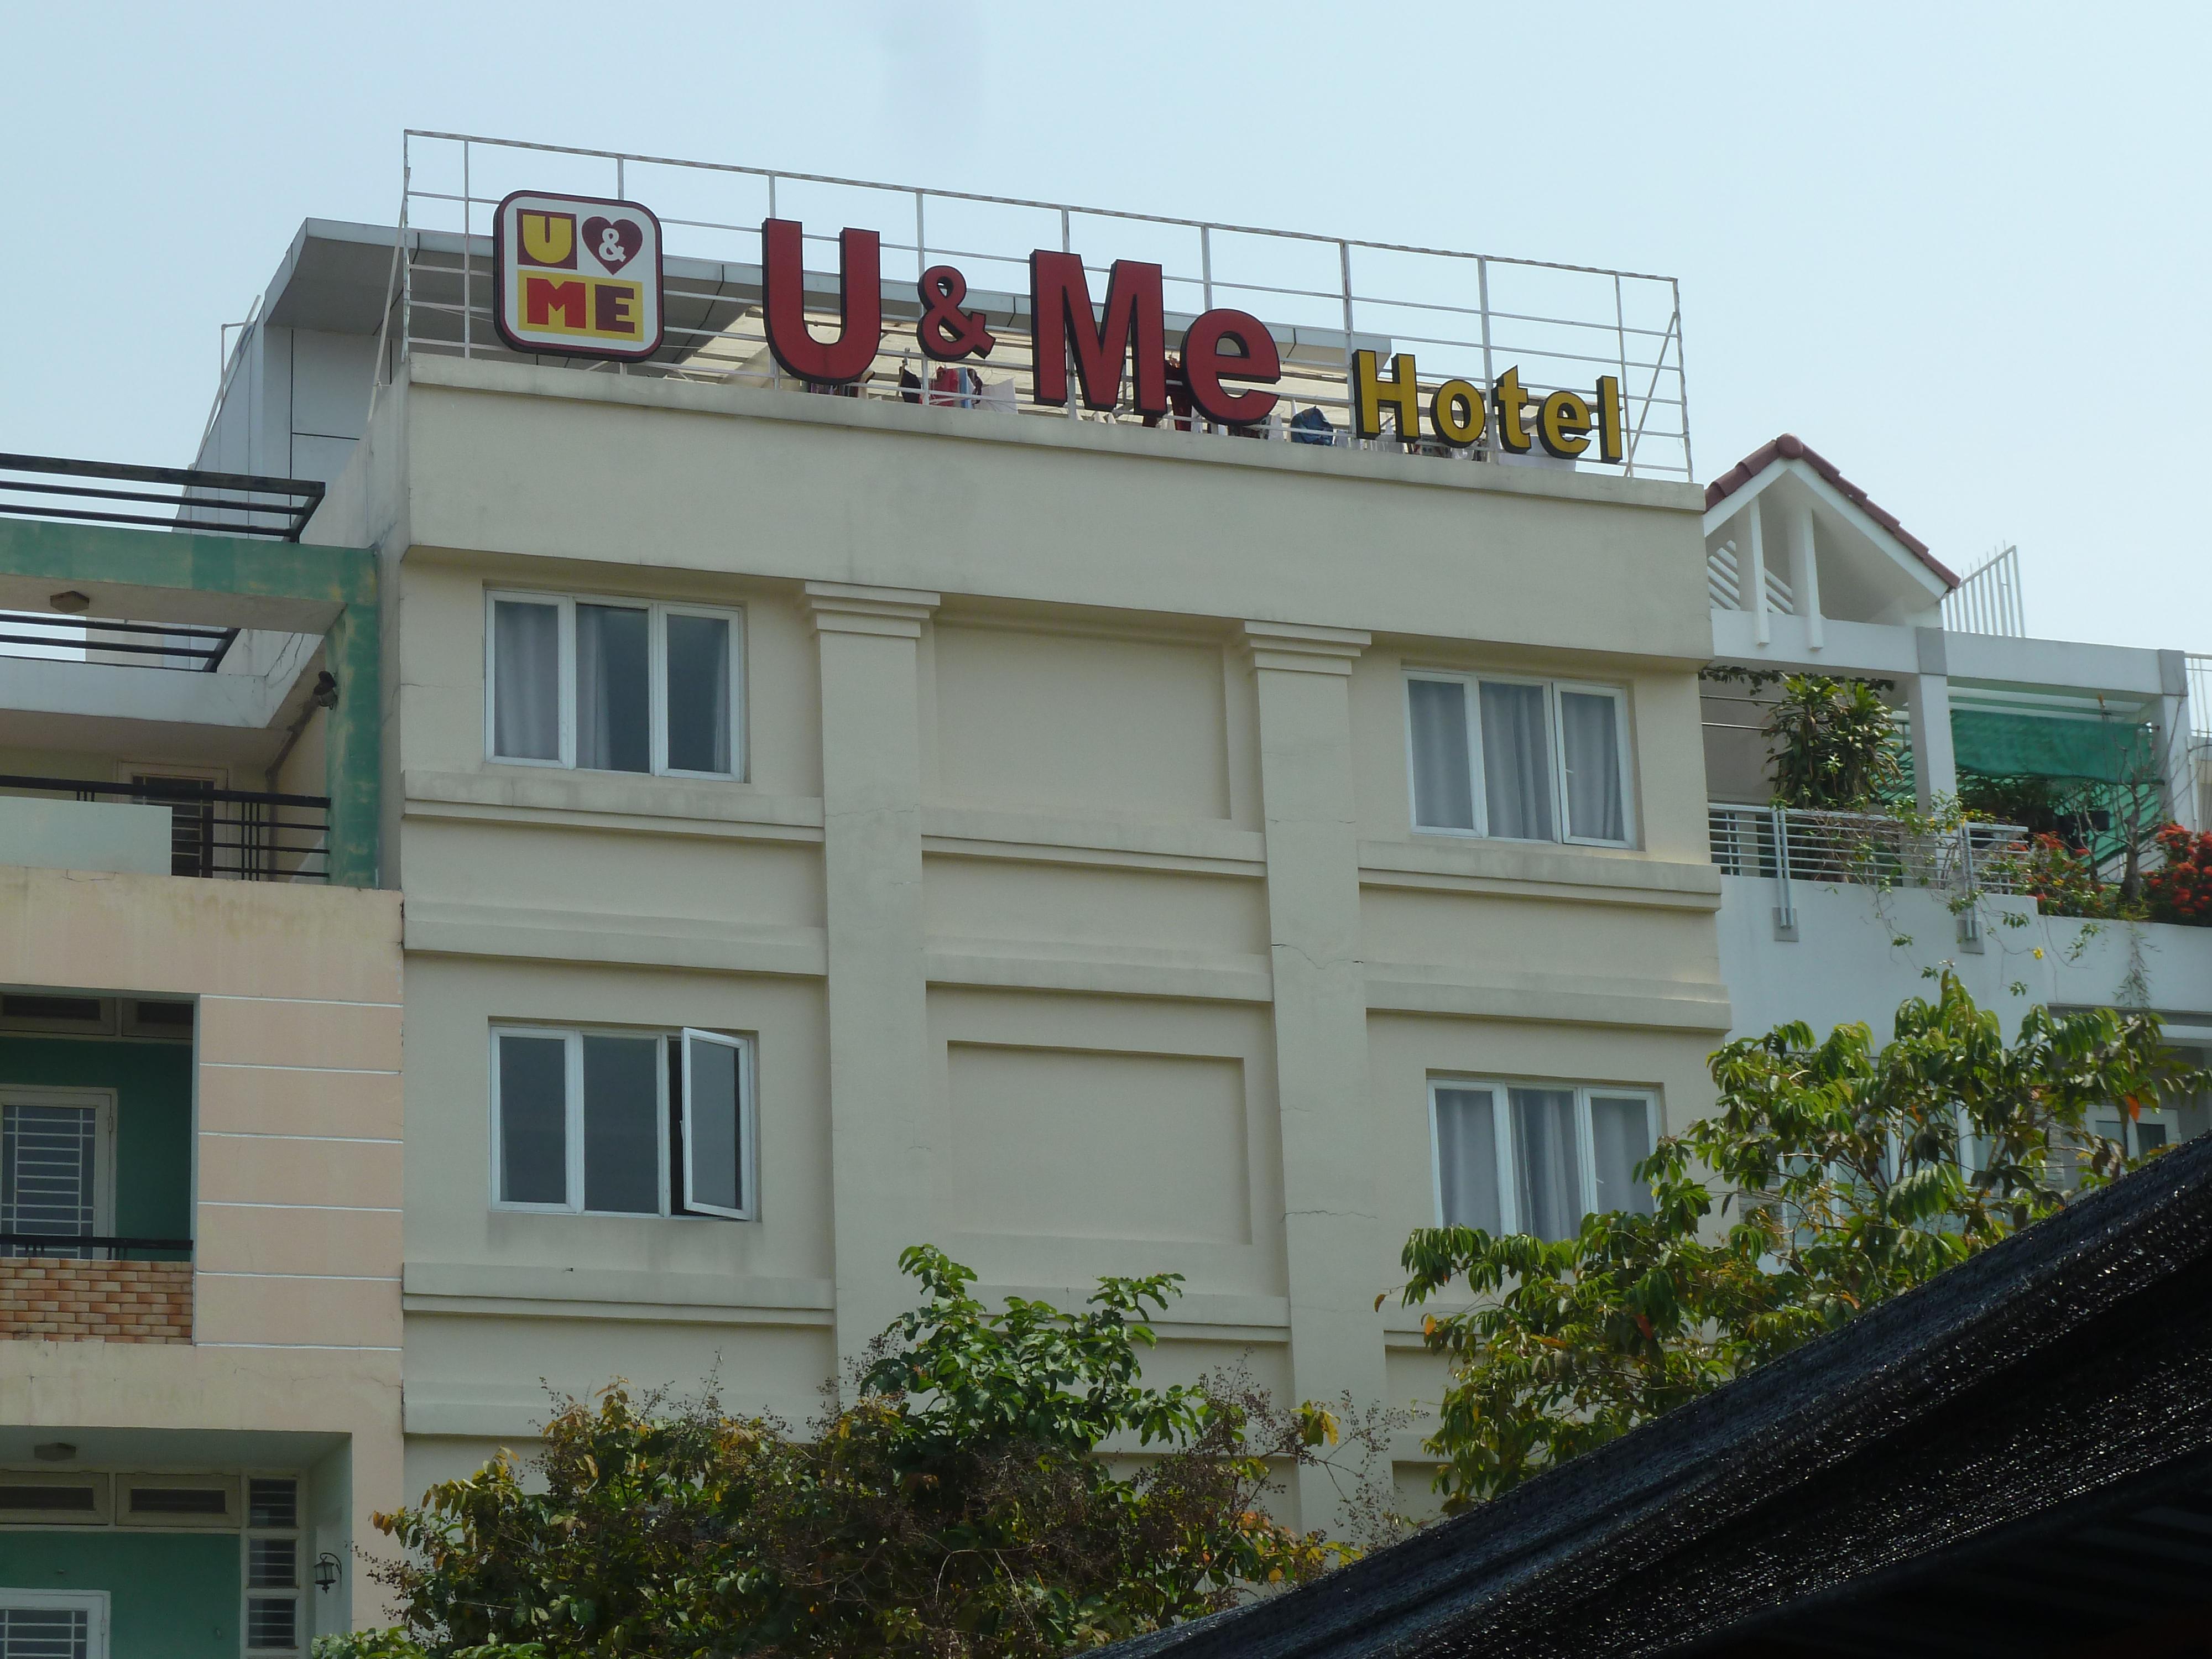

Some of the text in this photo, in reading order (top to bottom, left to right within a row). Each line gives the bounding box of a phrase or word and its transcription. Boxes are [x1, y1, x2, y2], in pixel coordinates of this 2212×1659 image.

[523, 214, 627, 264] U &
[526, 278, 635, 333] ME
[762, 218, 1623, 463] U & Me Hotel
